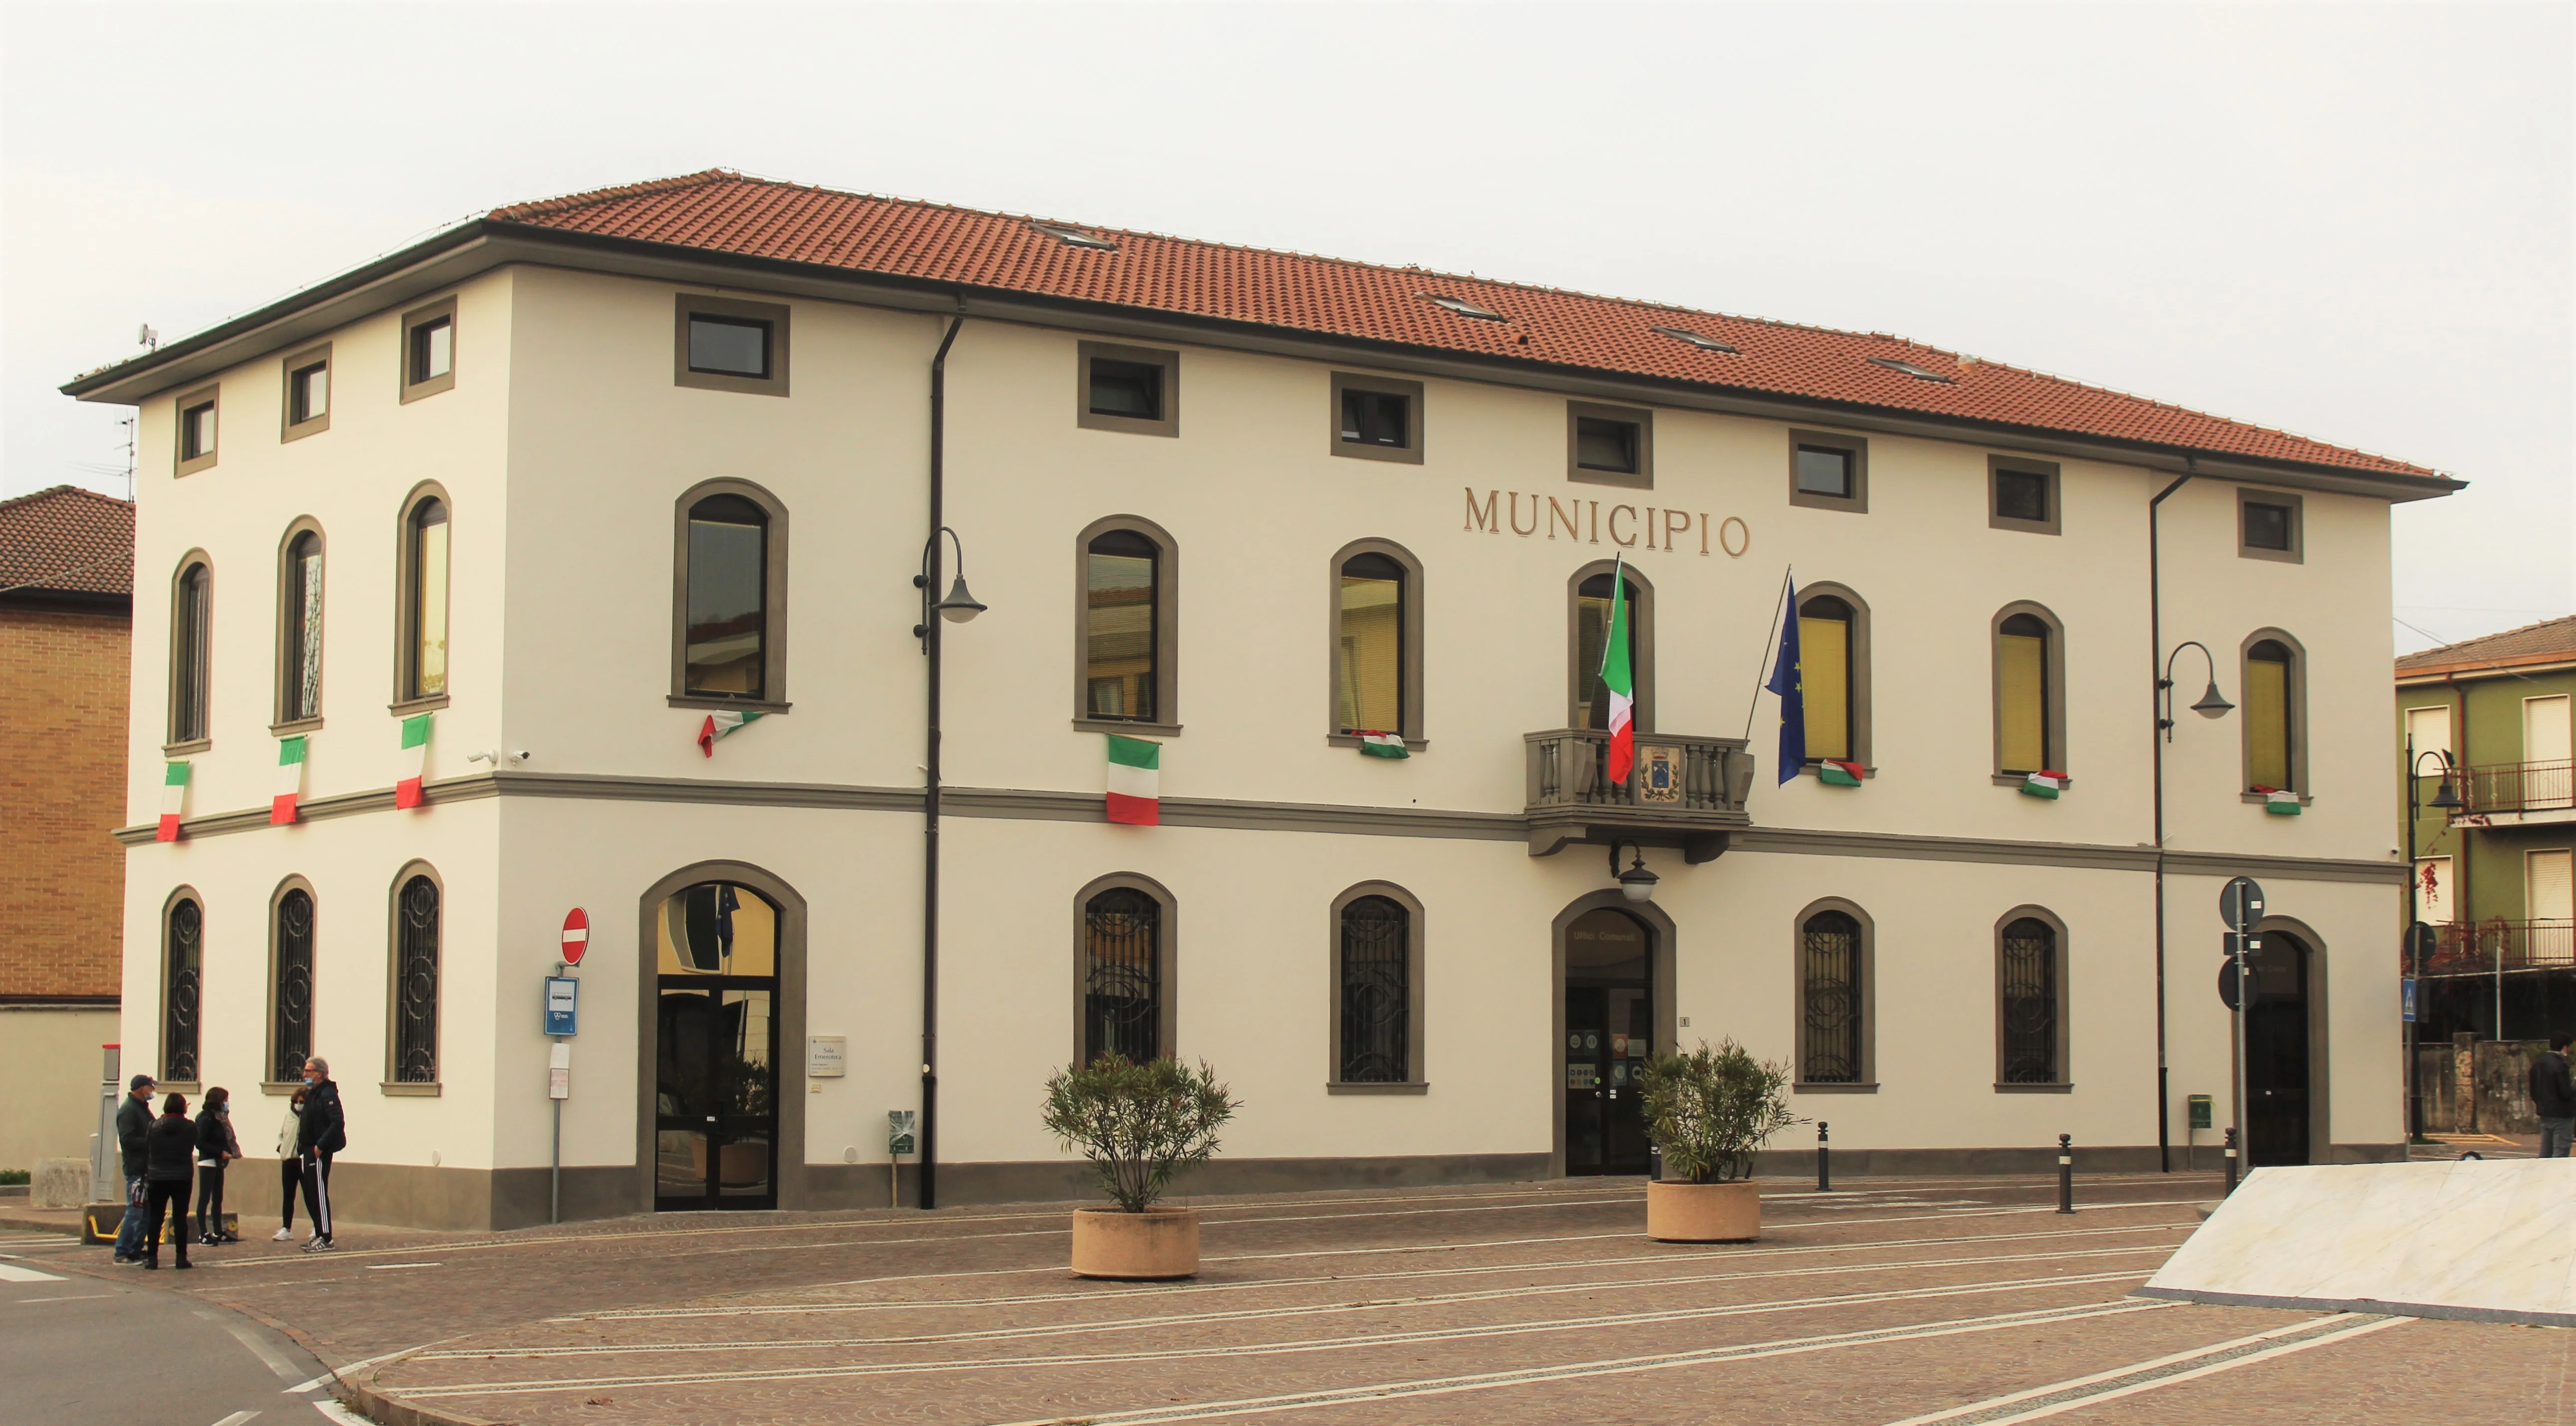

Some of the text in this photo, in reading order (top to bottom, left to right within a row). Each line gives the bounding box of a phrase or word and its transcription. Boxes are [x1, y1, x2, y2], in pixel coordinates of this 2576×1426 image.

[1464, 486, 1750, 557] MUNICIPIO
[1574, 930, 1635, 941] Uffici Comunali
